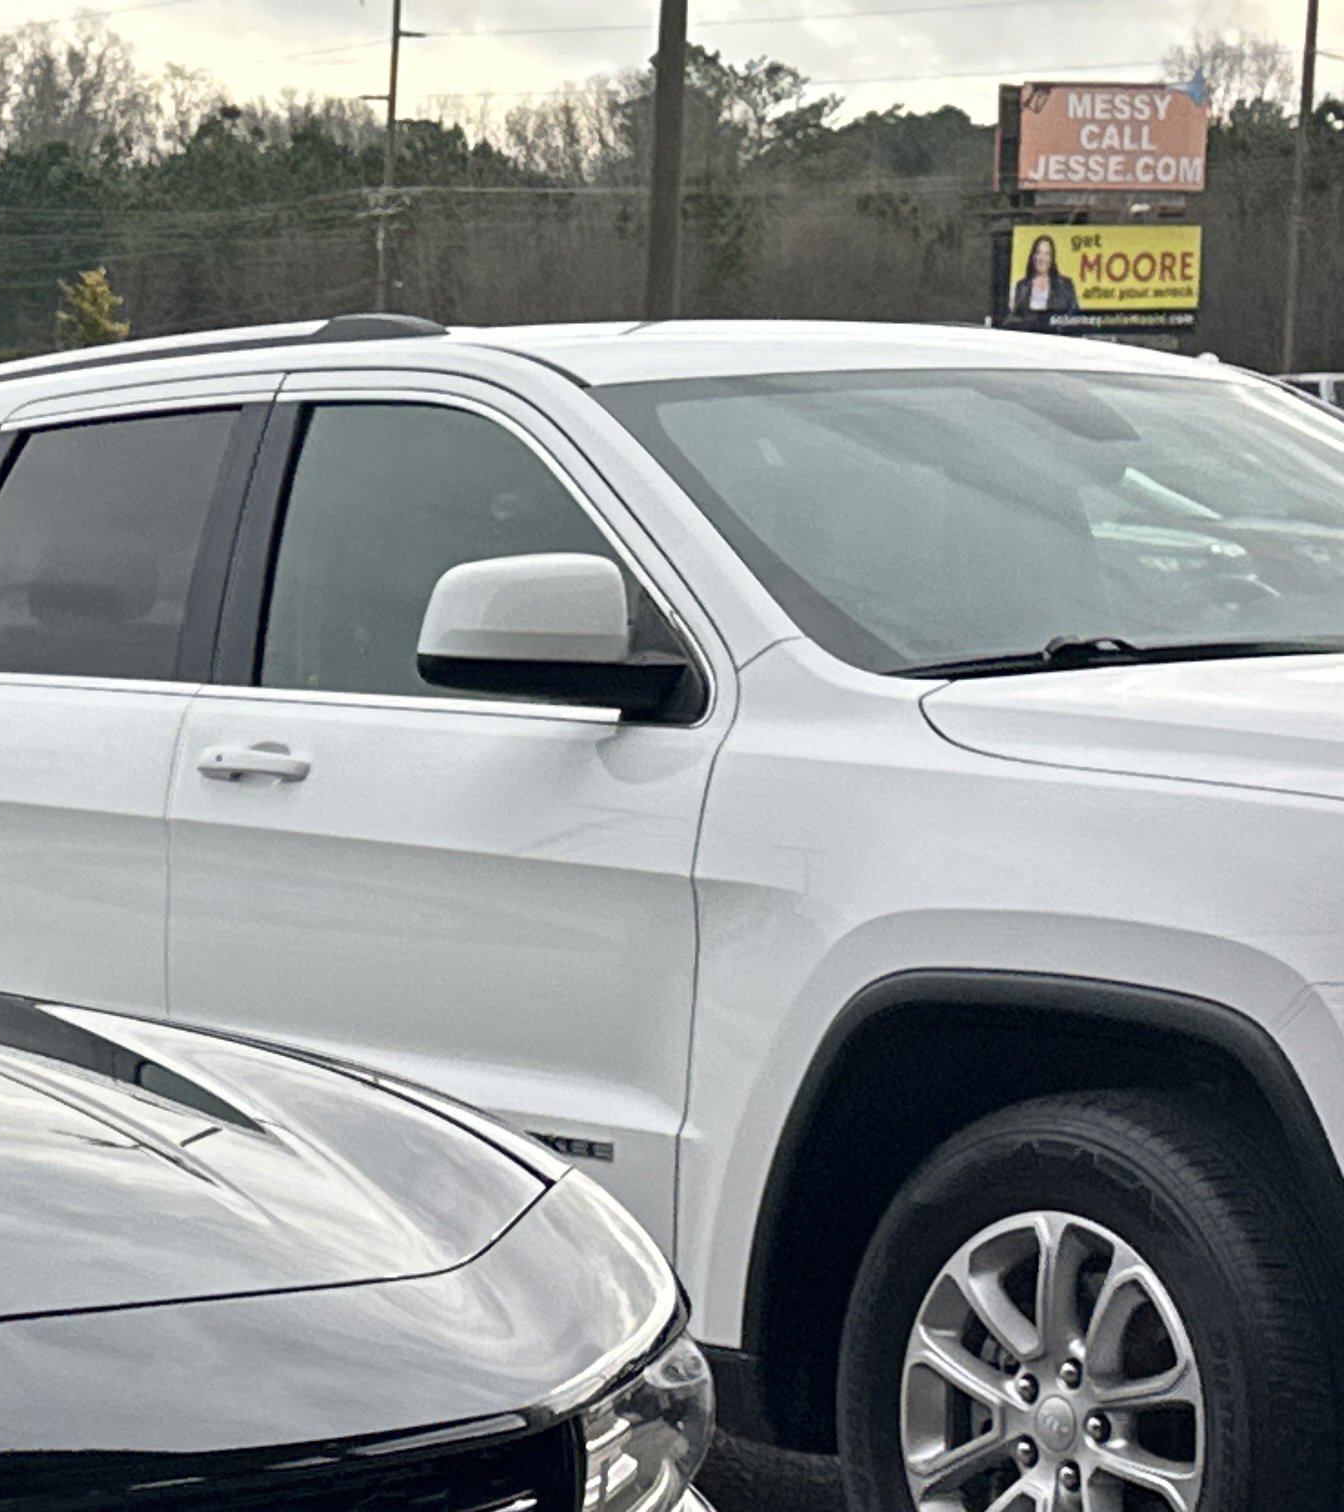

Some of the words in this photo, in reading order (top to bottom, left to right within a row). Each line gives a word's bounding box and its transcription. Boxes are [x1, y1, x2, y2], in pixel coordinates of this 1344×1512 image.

[1067, 92, 1173, 121] MESSY
[1079, 123, 1157, 151] CALL
[1028, 154, 1203, 184] JESSE.COM
[1070, 233, 1102, 251] get
[1079, 251, 1195, 283] MOORE
